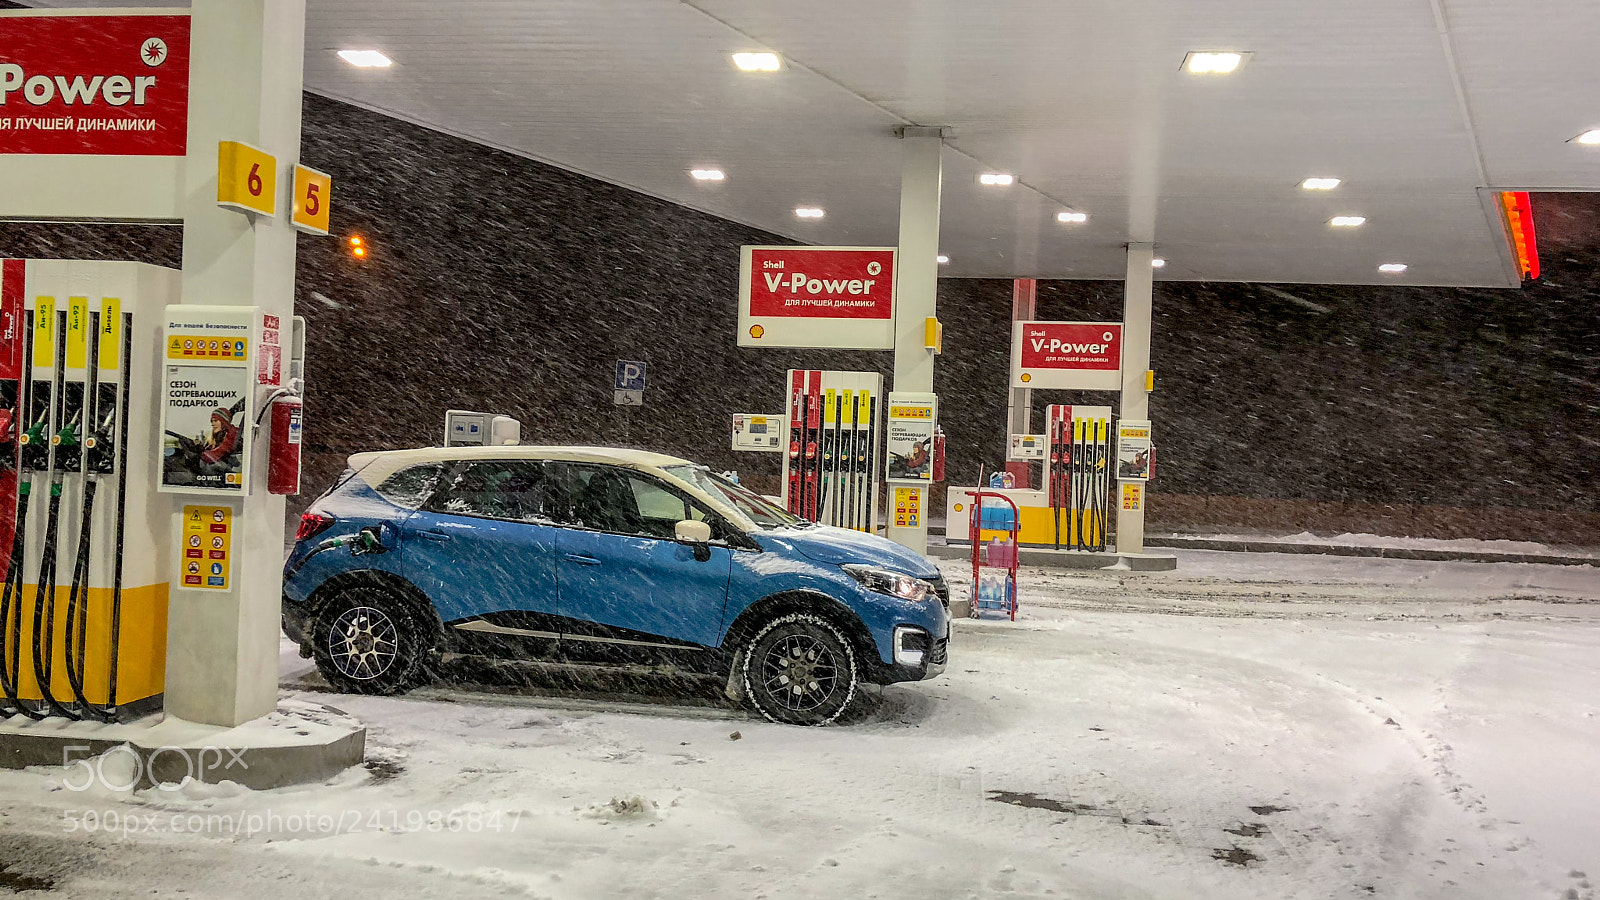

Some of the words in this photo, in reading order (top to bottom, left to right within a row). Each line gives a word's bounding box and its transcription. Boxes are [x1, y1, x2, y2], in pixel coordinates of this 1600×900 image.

[14, 116, 74, 131] ЛУЧШЕЙ
[76, 118, 156, 132] ДИНАМИКИ
[247, 163, 263, 198] 6
[304, 183, 320, 217] 5
[763, 260, 785, 270] Shell
[763, 272, 876, 295] V-Power
[784, 298, 800, 307] ДЛЯ
[801, 298, 833, 308] ЛУЧШЕЙ
[834, 299, 876, 309] ДИНАМИКИ
[39, 304, 47, 329] Аи-95
[104, 305, 113, 334] Дизель
[1030, 330, 1046, 338] Shell
[1030, 338, 1109, 354] V-Power
[624, 364, 640, 387] P
[169, 380, 197, 389] СЕЗОН
[169, 390, 238, 400] СОГРЕВАЮЩИХ
[169, 399, 219, 409] ПОДАРКОВ
